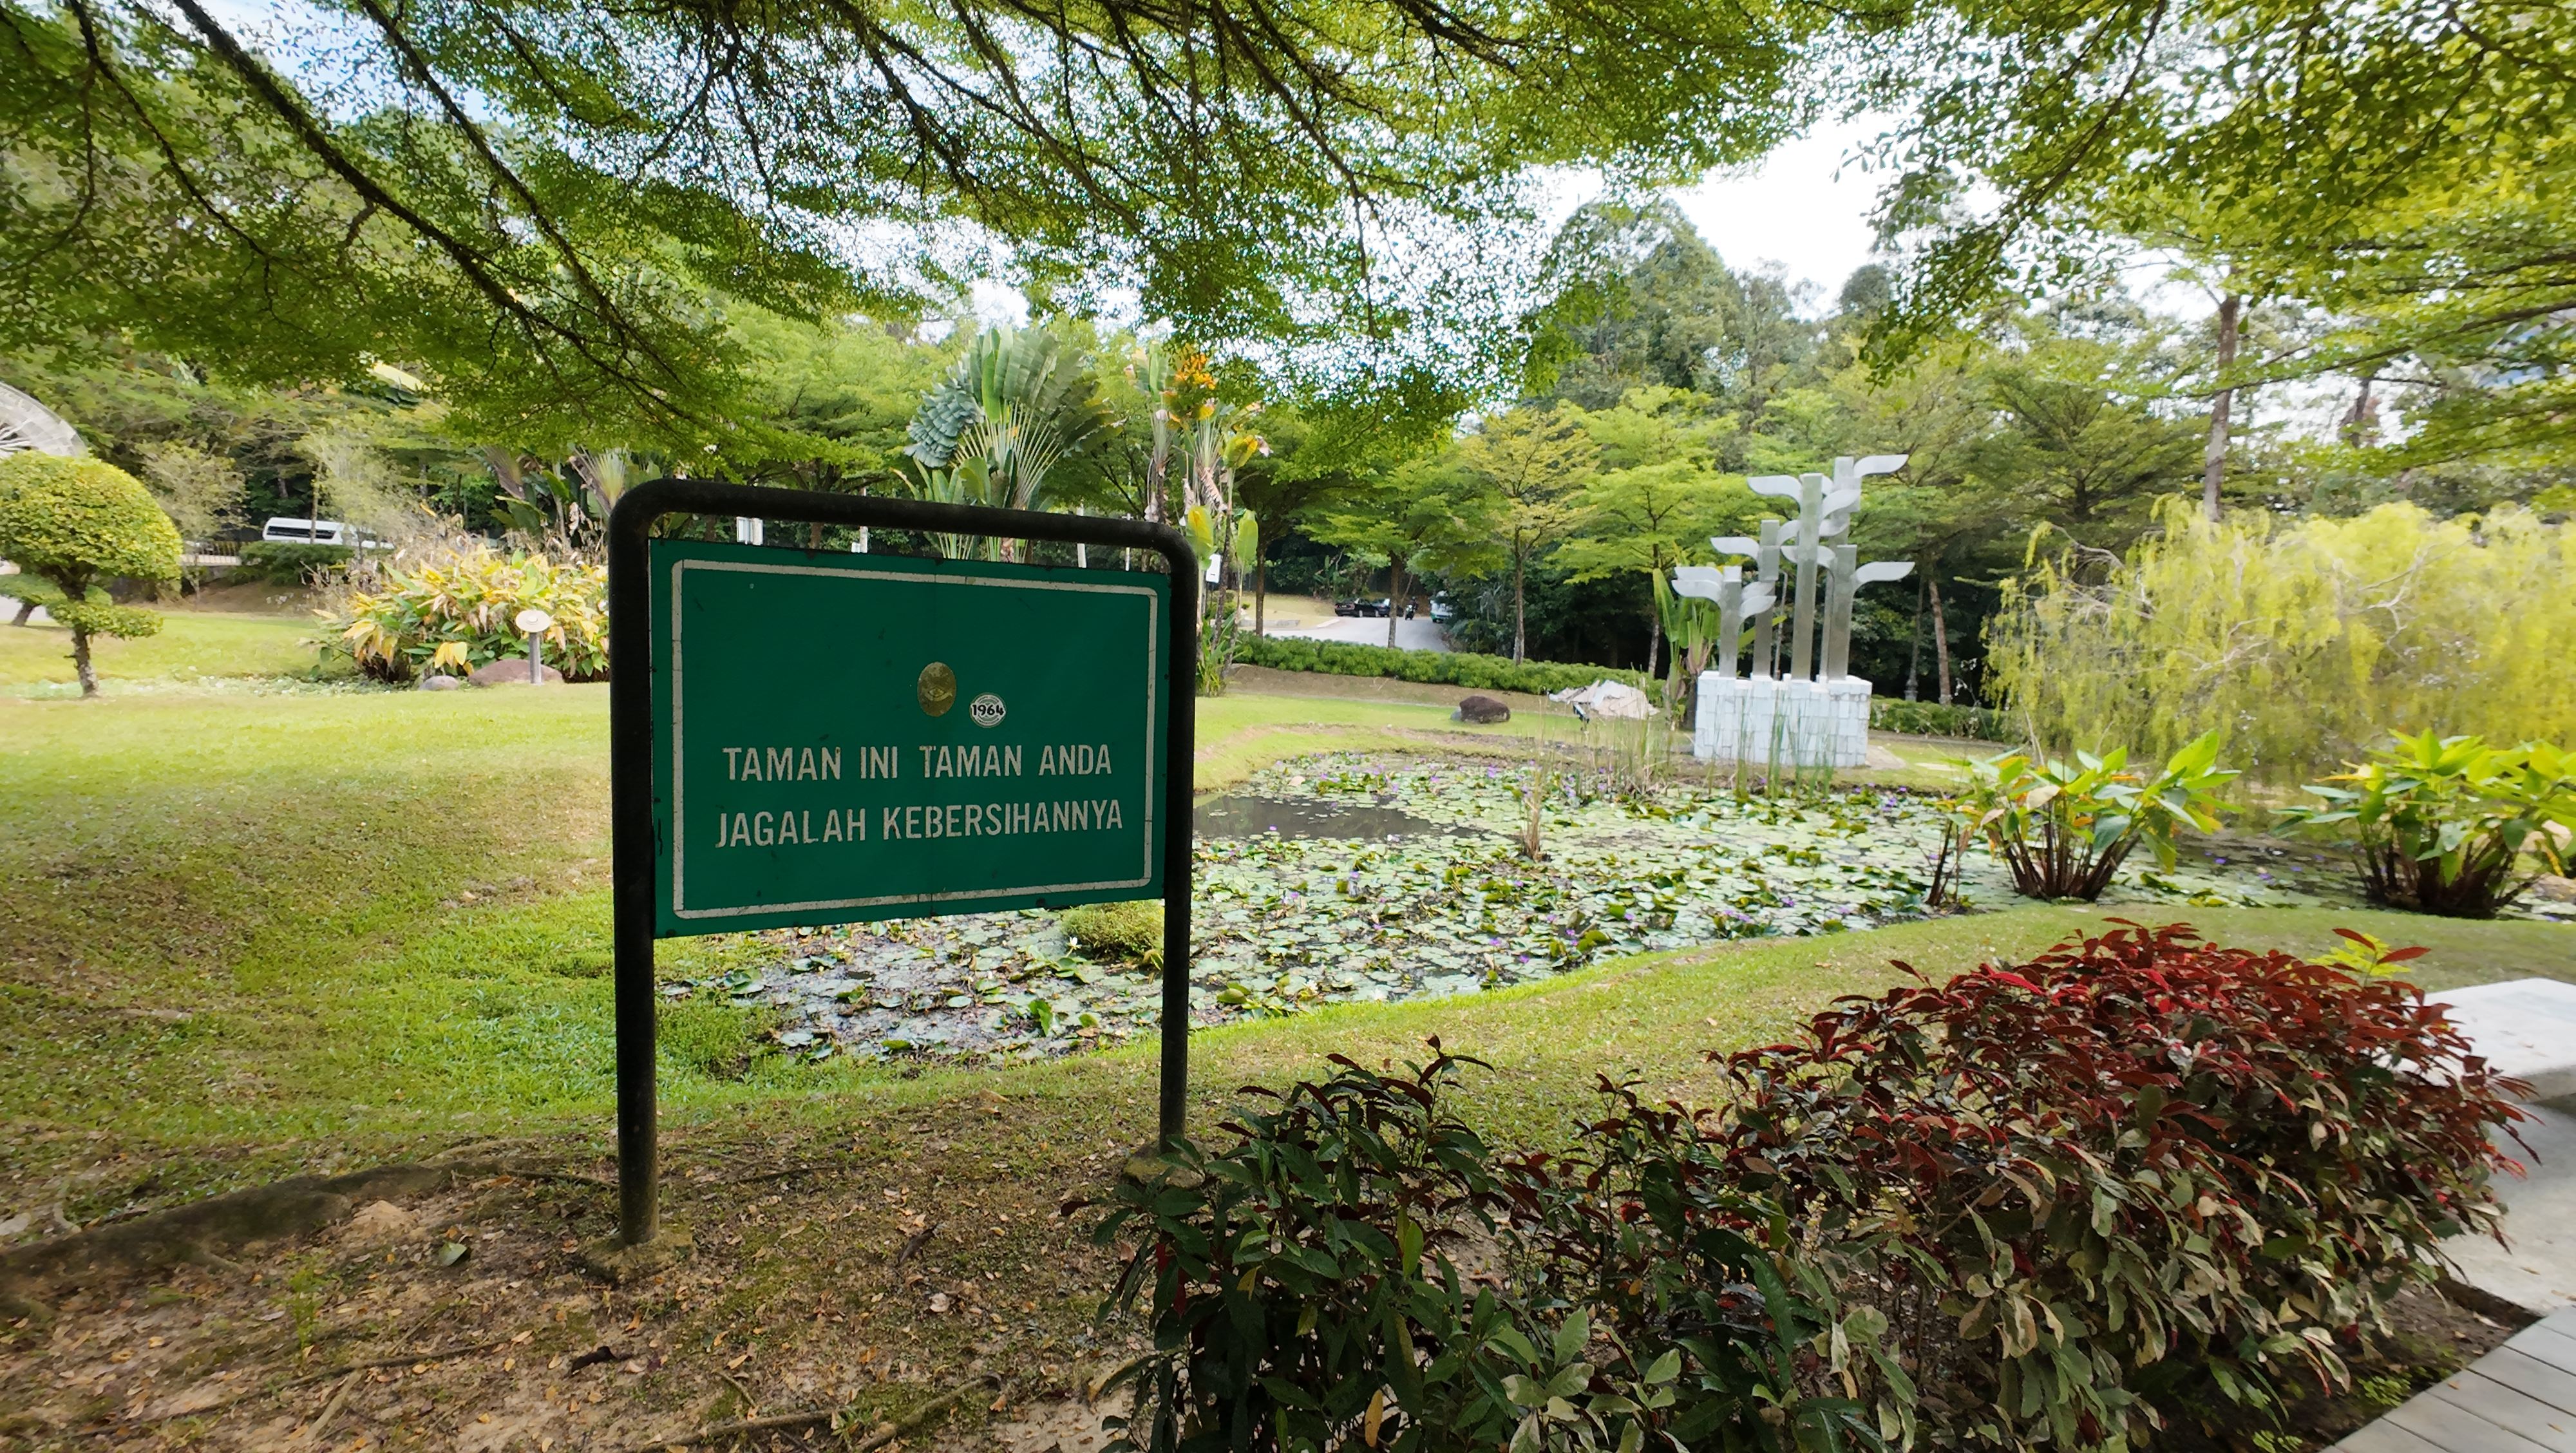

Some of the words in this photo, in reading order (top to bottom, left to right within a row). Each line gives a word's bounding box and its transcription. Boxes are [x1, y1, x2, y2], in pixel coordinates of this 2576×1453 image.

[972, 704, 1004, 716] 1964
[723, 747, 841, 781] TAMAN
[860, 746, 898, 779] INI
[919, 745, 1022, 778] TAMAN
[1038, 744, 1112, 775] ANDA
[715, 809, 866, 848] JAGALAH
[883, 799, 1122, 840] KEBERSIHANNYA
